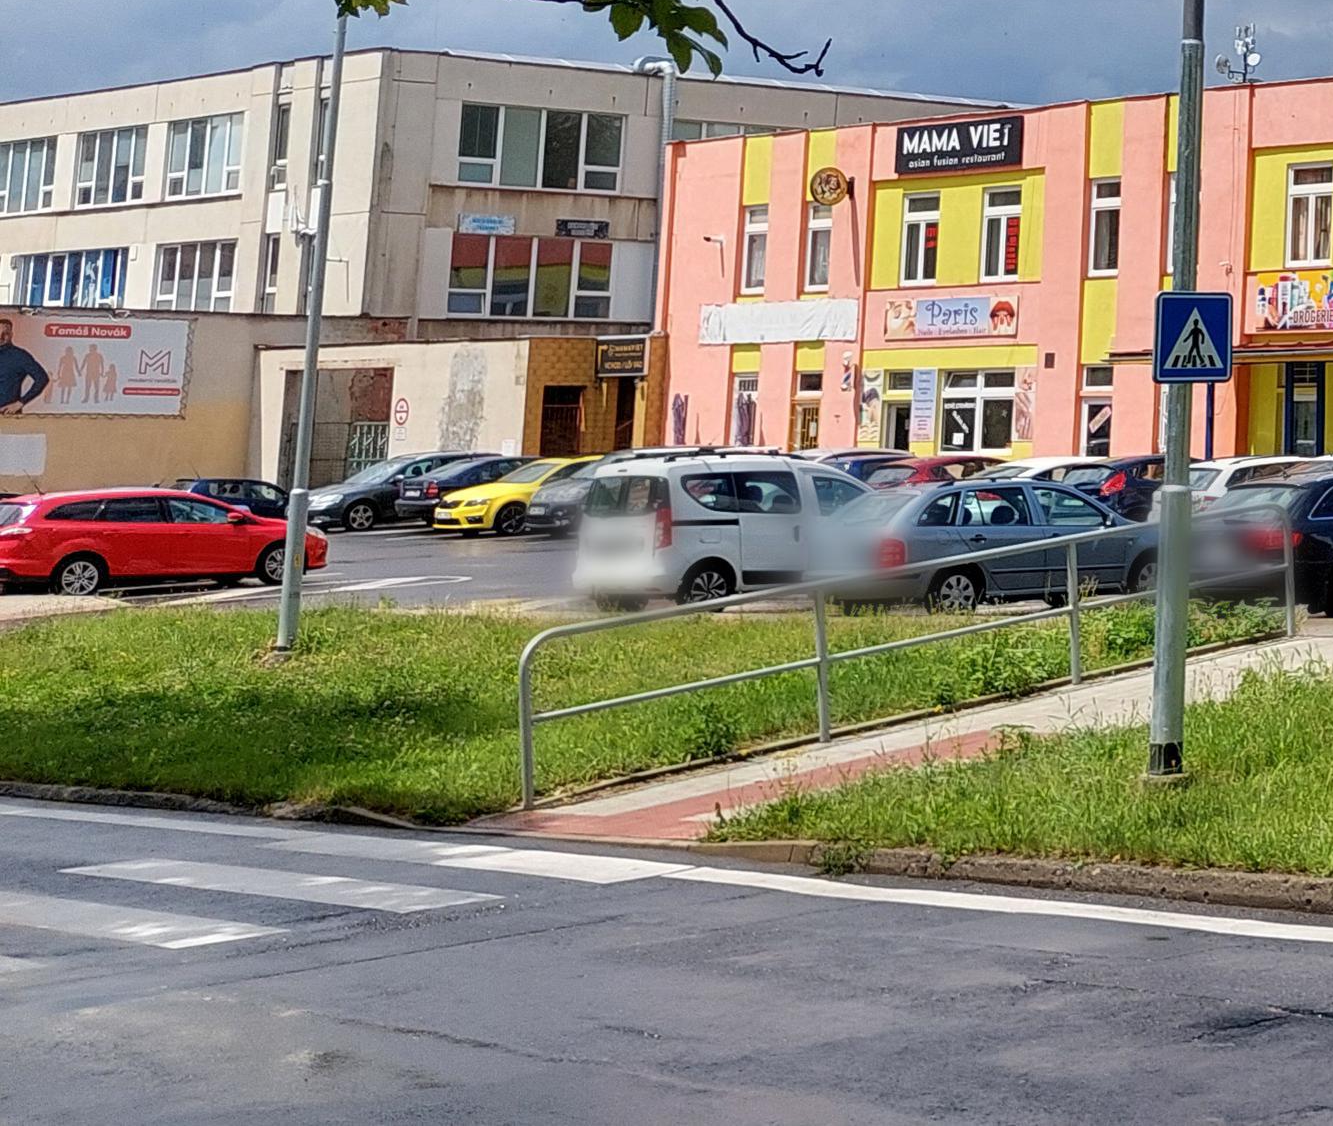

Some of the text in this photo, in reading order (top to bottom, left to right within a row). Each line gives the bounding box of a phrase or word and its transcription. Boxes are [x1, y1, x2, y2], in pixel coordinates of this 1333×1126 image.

[903, 123, 1012, 154] MAMA VIET
[908, 151, 1005, 168] asian fusion restaurant
[925, 301, 978, 326] Paris
[1293, 310, 1333, 323] DROGERIE
[50, 326, 127, 337] Tomáš Novák
